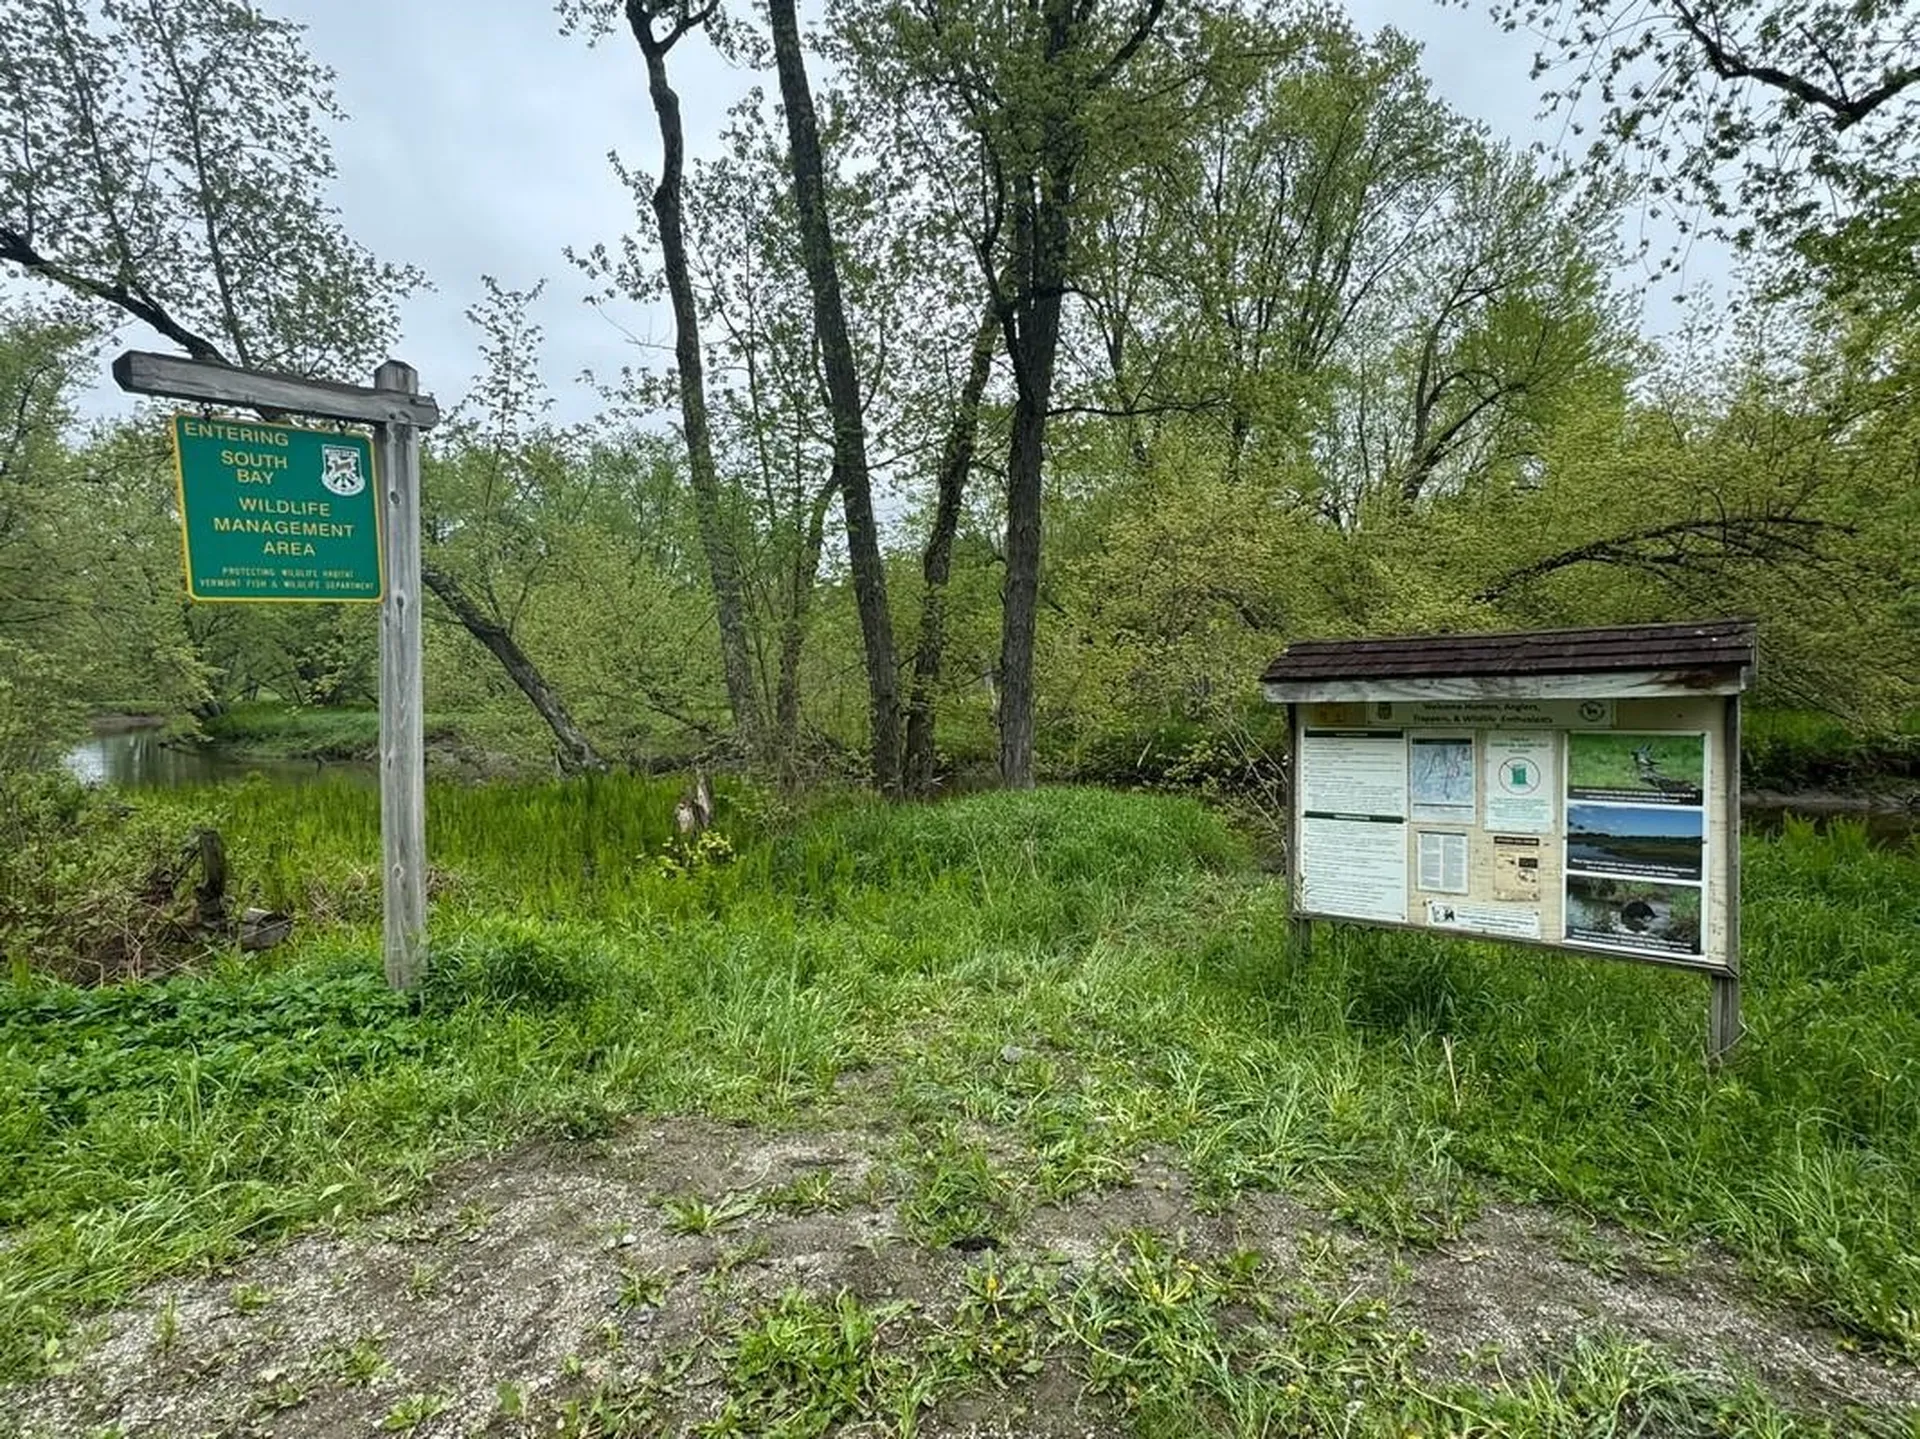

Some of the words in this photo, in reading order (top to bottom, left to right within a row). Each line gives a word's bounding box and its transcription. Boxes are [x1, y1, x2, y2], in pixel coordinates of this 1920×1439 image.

[184, 421, 289, 447] ENTERING
[221, 450, 288, 469] SOUTH
[237, 468, 274, 485] BAY
[239, 497, 331, 517] WILDLIFE
[213, 517, 354, 537] MANAGEMENT
[263, 541, 316, 557] AREA
[222, 566, 275, 577] PROTECTING
[281, 568, 317, 578] WILDLIFE
[322, 570, 354, 579] HABITAT
[200, 578, 241, 588] VERMONT
[246, 579, 267, 588] FISH
[271, 580, 278, 589] &
[283, 580, 320, 590] WILDLIFE
[325, 582, 374, 591] DEPARTMENT
[1504, 703, 1540, 712] Anglers,
[1502, 715, 1553, 723] Enthusiasts
